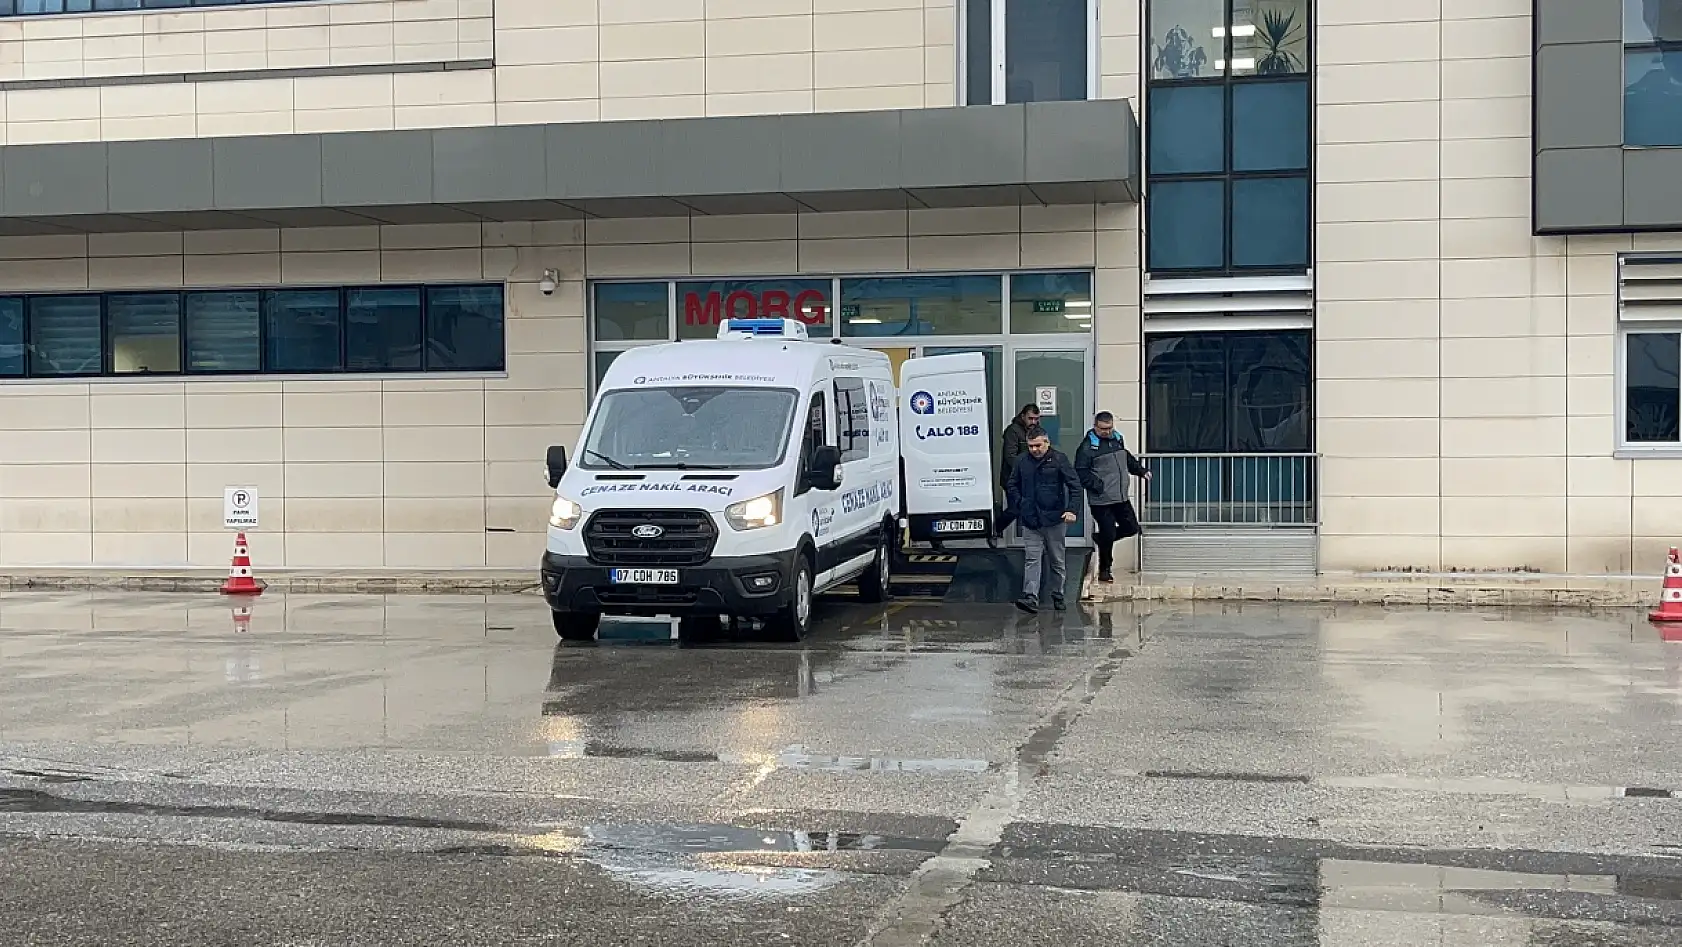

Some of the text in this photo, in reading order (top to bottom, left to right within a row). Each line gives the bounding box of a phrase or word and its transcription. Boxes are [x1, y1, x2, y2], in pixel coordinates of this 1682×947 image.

[685, 289, 826, 325] MORG
[927, 425, 979, 437] ALO 188
[581, 481, 734, 497] CENAZE NAKİL ARACI
[936, 521, 947, 530] 07
[616, 570, 630, 581] 07
[633, 570, 653, 582] CDH
